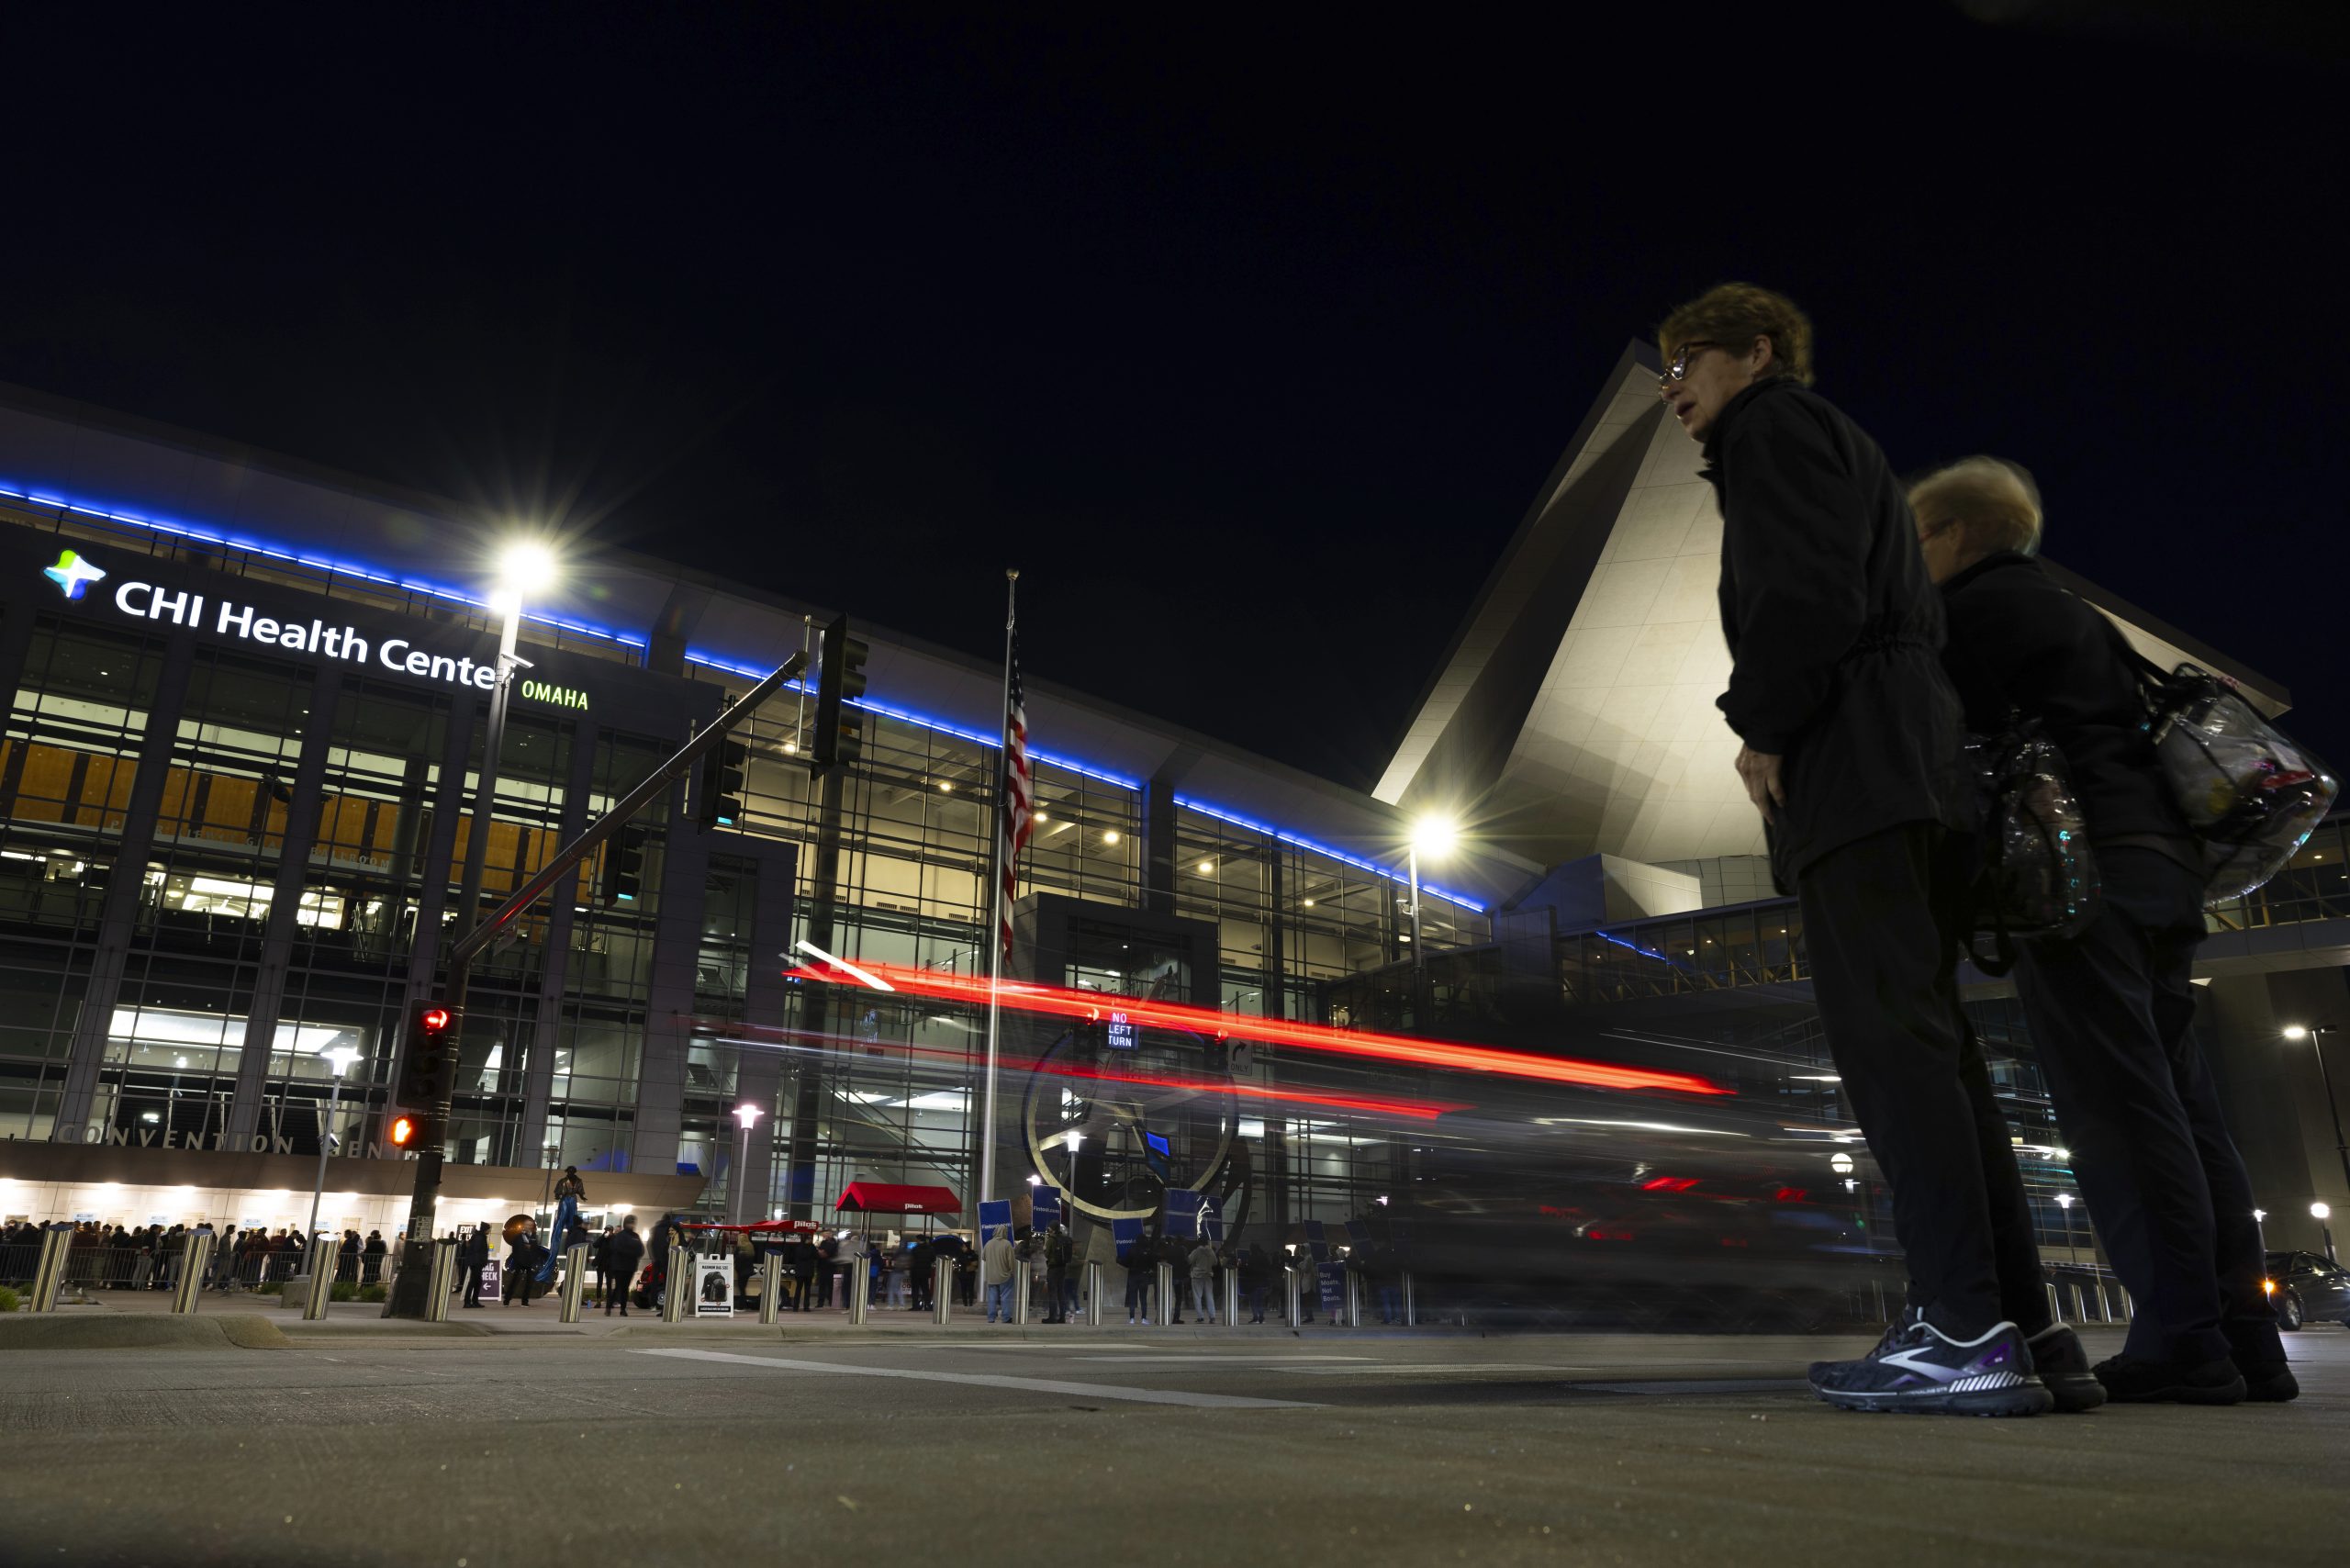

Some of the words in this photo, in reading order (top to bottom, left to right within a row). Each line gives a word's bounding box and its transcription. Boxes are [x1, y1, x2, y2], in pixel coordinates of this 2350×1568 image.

[116, 581, 203, 628] CHI
[217, 600, 367, 663] Health
[379, 639, 514, 690] Cente
[522, 680, 588, 711] OMAHA
[1112, 1012, 1127, 1024] NO
[1108, 1025, 1132, 1036] LEFT
[1108, 1036, 1132, 1047] TURN
[1230, 1063, 1248, 1072] ONLY
[57, 1125, 295, 1155] CONVENTION
[460, 1226, 474, 1234] EXIT
[458, 1233, 473, 1241] OLY
[481, 1271, 498, 1282] HECK
